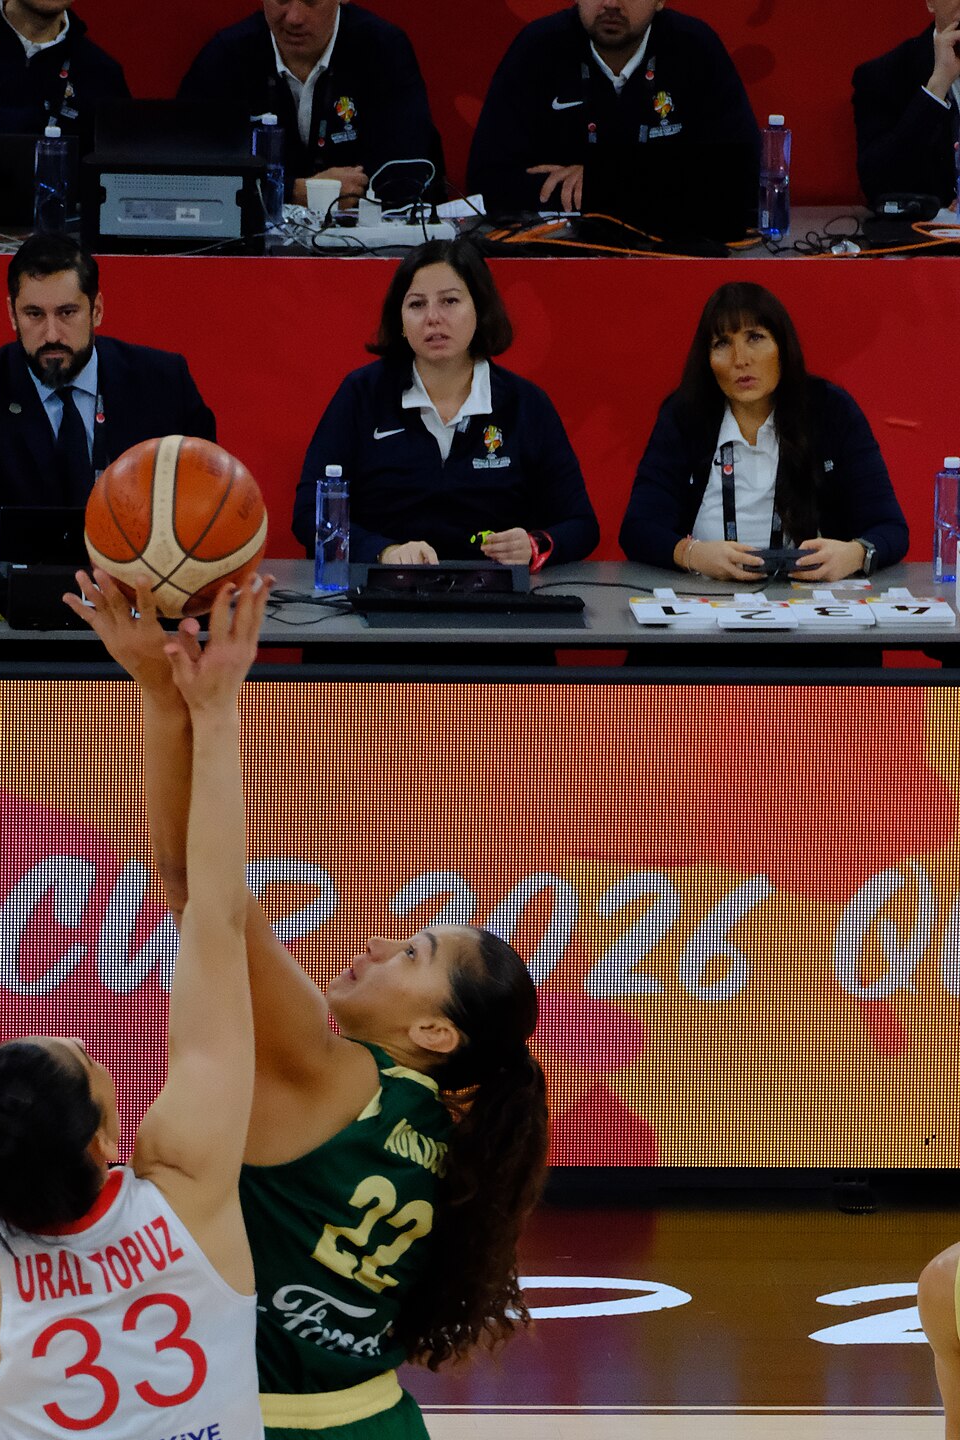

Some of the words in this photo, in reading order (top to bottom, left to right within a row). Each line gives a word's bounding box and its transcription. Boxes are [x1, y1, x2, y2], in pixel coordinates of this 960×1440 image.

[14, 1249, 93, 1303] URAL
[88, 1215, 185, 1294] TOPUZ
[310, 1175, 434, 1294] 22
[31, 1293, 208, 1431] 33
